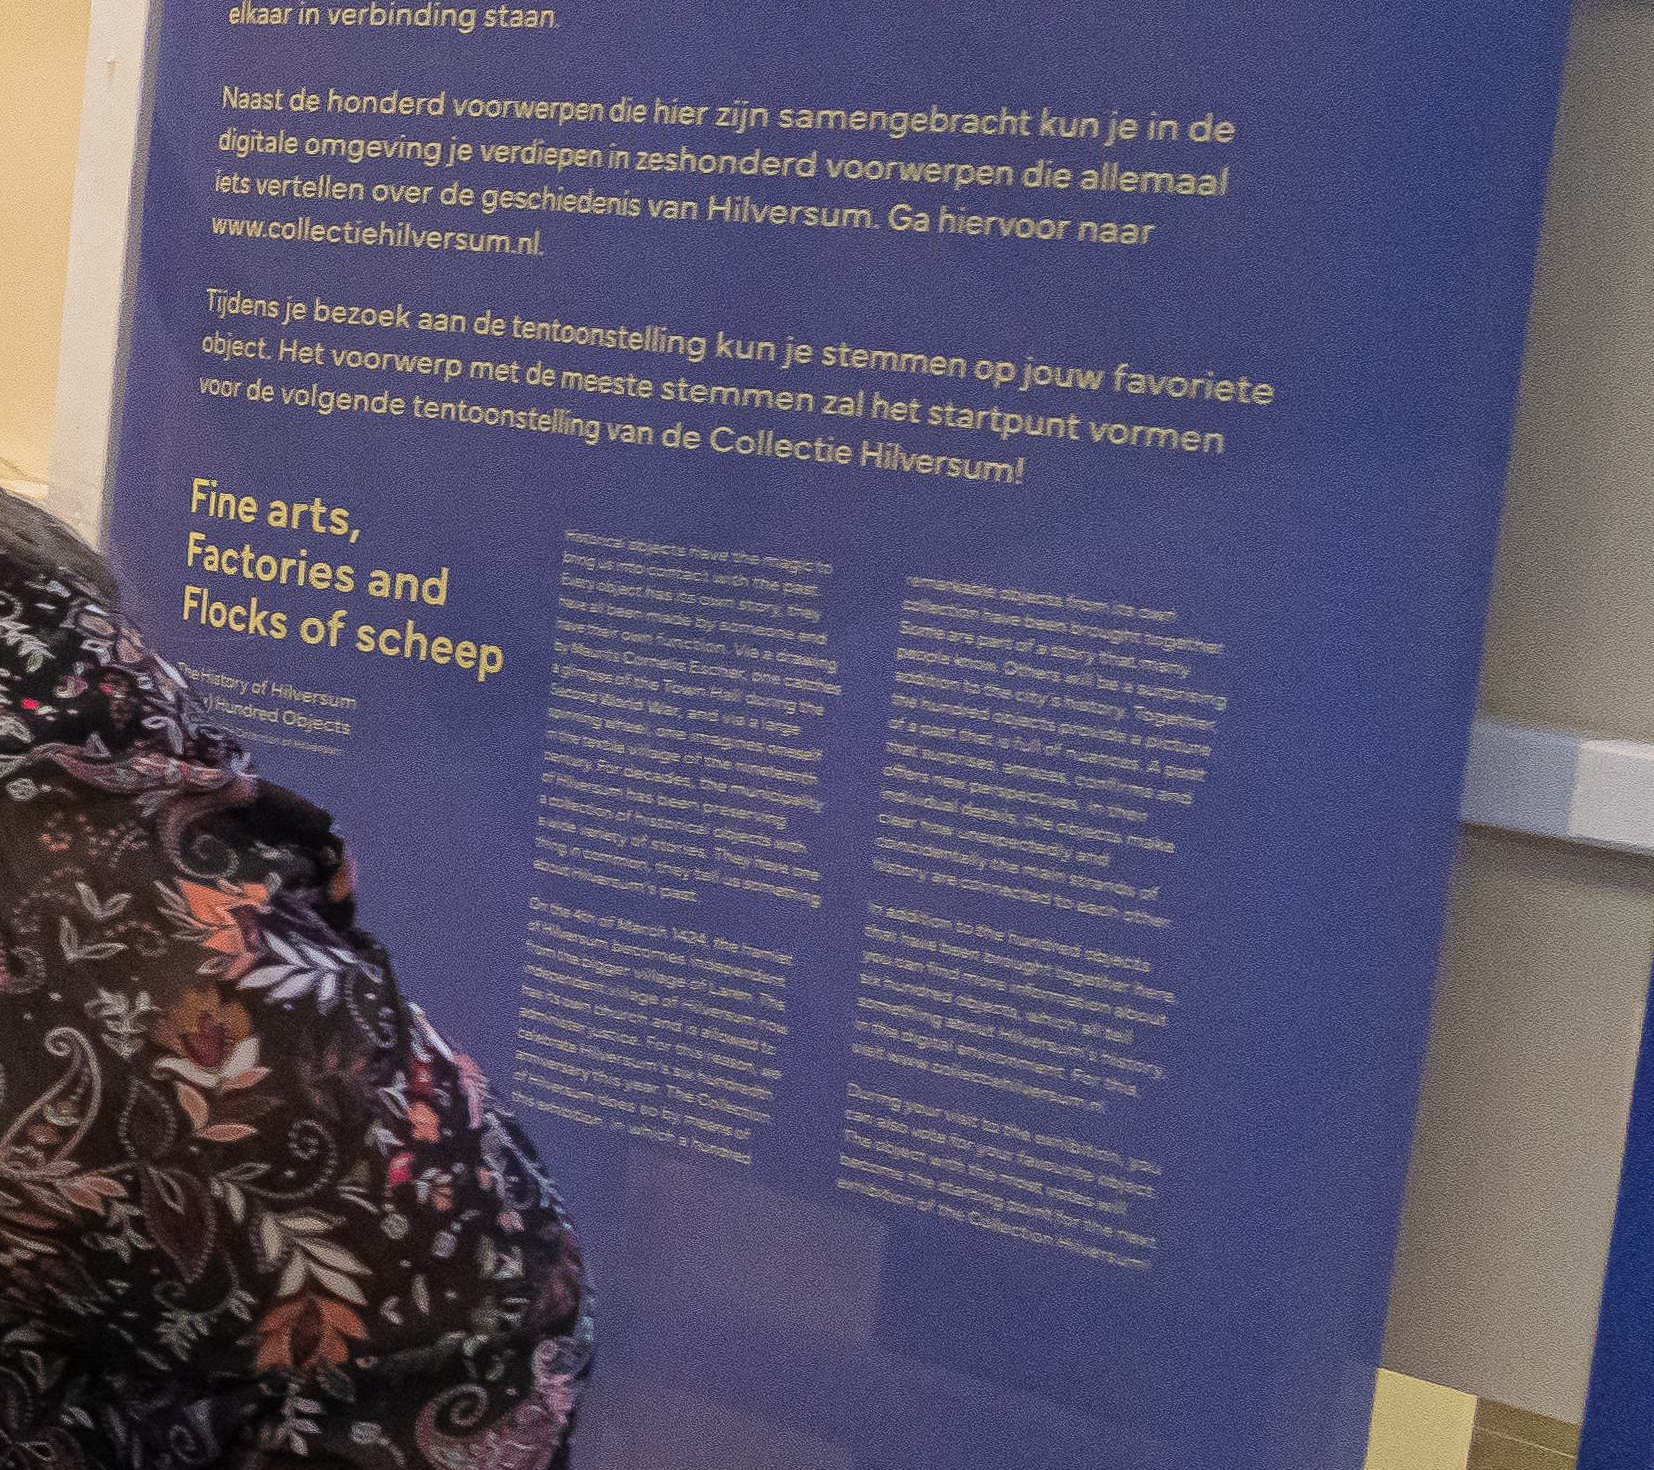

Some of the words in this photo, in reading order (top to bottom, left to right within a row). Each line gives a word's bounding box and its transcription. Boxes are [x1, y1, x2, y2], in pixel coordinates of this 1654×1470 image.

[222, 85, 284, 111] Naast
[288, 87, 321, 113] de
[326, 89, 446, 117] honderd
[453, 98, 605, 124] voorwerpen
[608, 96, 648, 124] die
[652, 98, 709, 126] hier
[715, 100, 770, 134] zijn
[779, 107, 1030, 139] samengebracht
[1038, 107, 1100, 139] kun
[1104, 117, 1139, 147] je
[1146, 118, 1180, 141] in
[1187, 113, 1236, 144] de
[212, 217, 543, 254] www.collectiehilversum.nl.
[199, 377, 242, 398] voor
[245, 378, 275, 403] de
[281, 384, 405, 416] volgende
[413, 397, 601, 446] tentoonstelling
[606, 422, 655, 445] van
[660, 422, 702, 451] de
[709, 425, 852, 465] Collectie
[860, 441, 1025, 483] Hilversum!
[190, 477, 258, 523] Fine
[267, 498, 359, 543] arts,
[187, 531, 354, 592] Factories
[367, 567, 449, 606] and
[183, 585, 287, 640] Flocks
[299, 609, 347, 647] of
[357, 621, 504, 681] scheep
